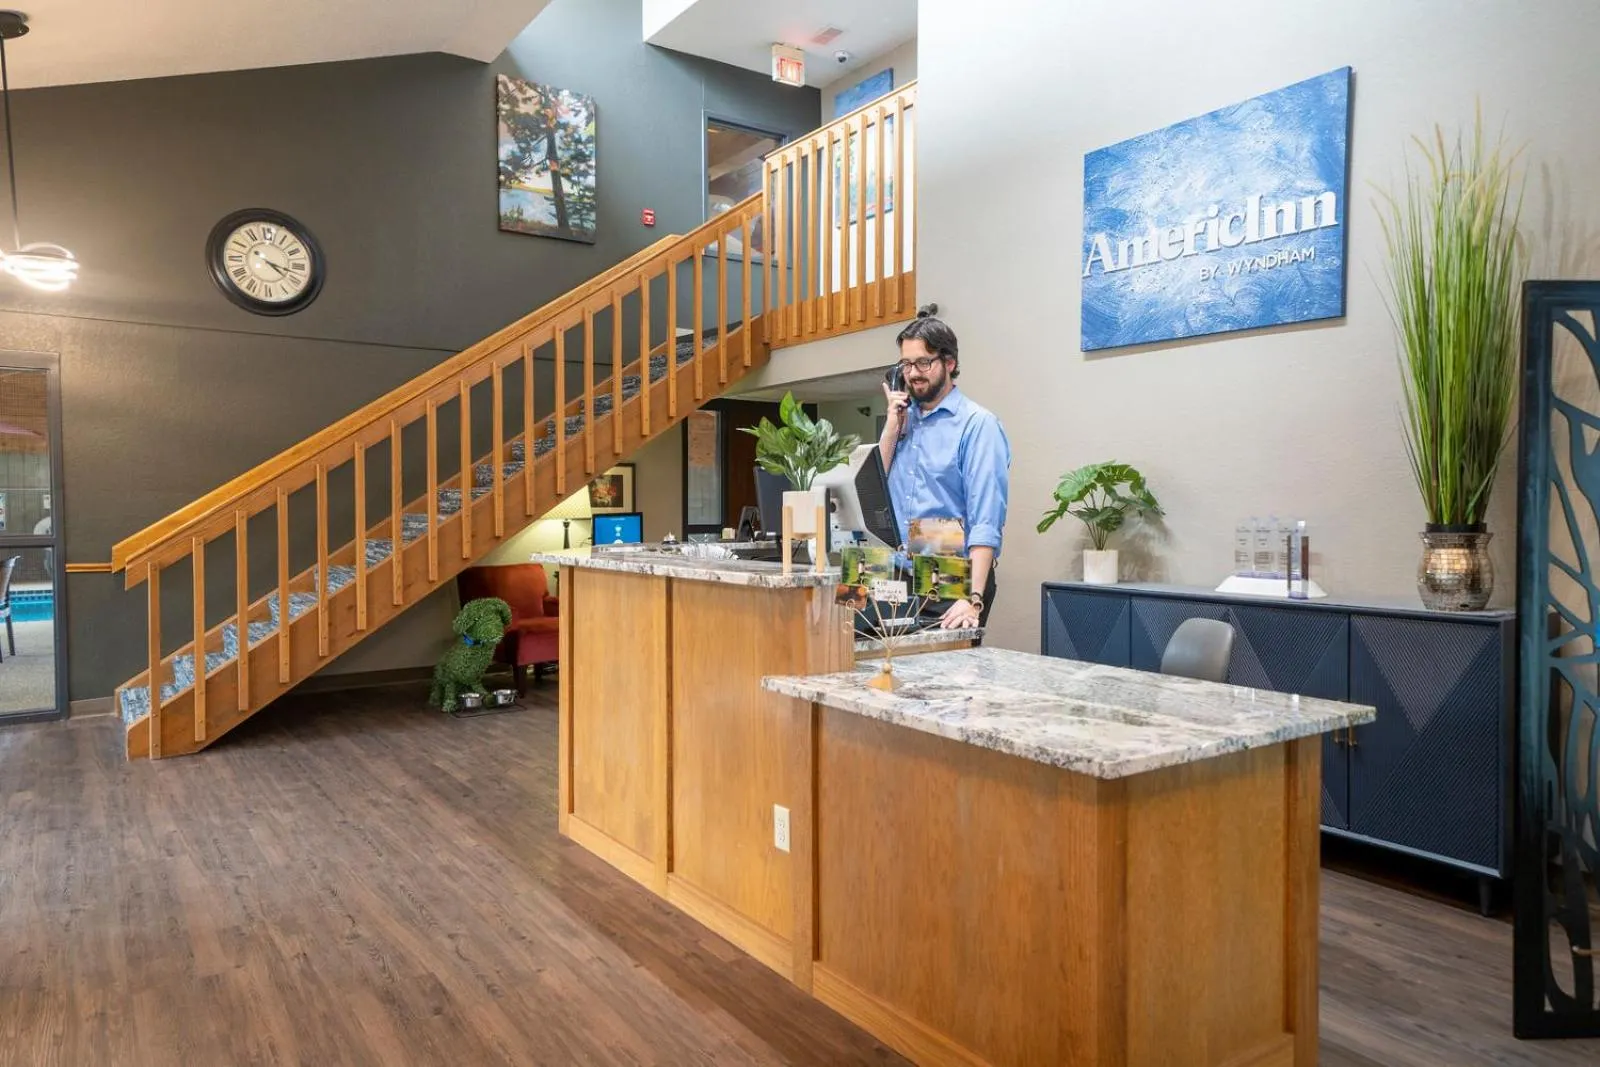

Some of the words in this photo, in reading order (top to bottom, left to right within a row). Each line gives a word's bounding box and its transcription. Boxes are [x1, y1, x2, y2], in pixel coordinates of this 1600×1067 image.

[1082, 190, 1339, 279] AmericInn
[1199, 266, 1219, 282] BY
[1228, 247, 1315, 276] WYNDHAM
